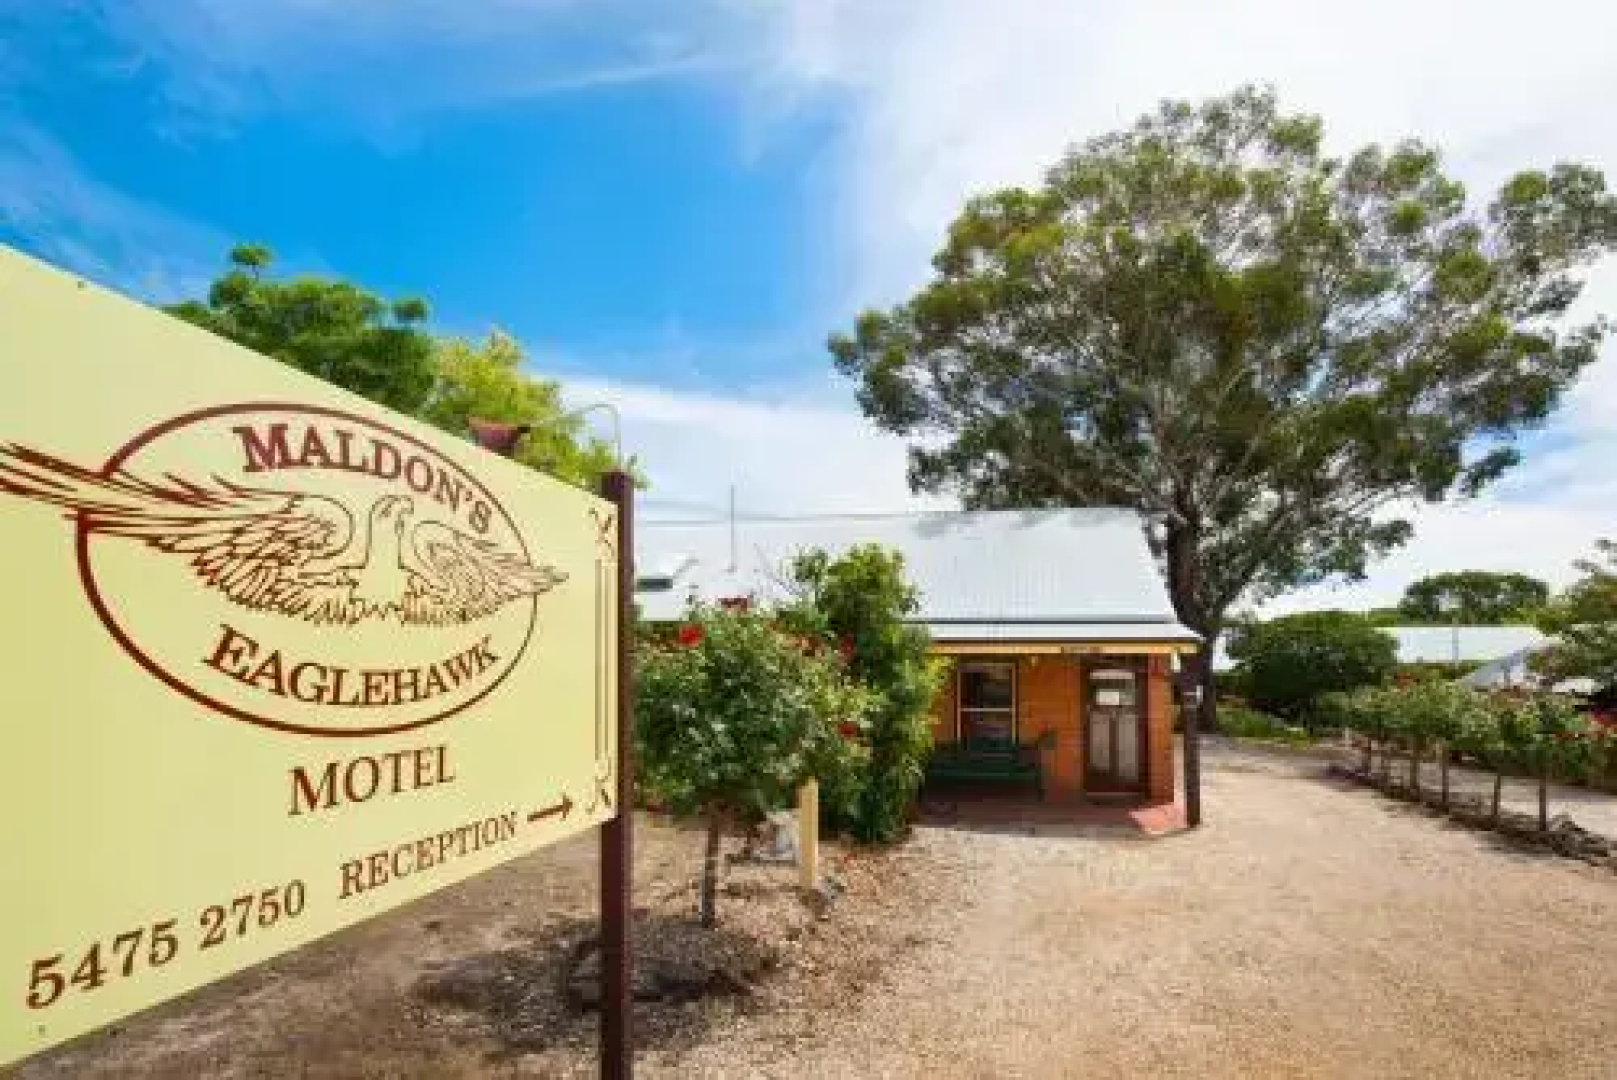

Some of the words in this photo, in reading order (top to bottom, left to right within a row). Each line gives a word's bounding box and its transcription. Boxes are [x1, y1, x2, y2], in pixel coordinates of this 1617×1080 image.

[233, 422, 493, 535] MALDON'S
[202, 624, 500, 707] EAGLEHAWK
[288, 743, 456, 816] MOTEL
[26, 918, 179, 1010] 5475
[199, 879, 306, 951] 2750
[339, 810, 518, 900] RECEPTION
